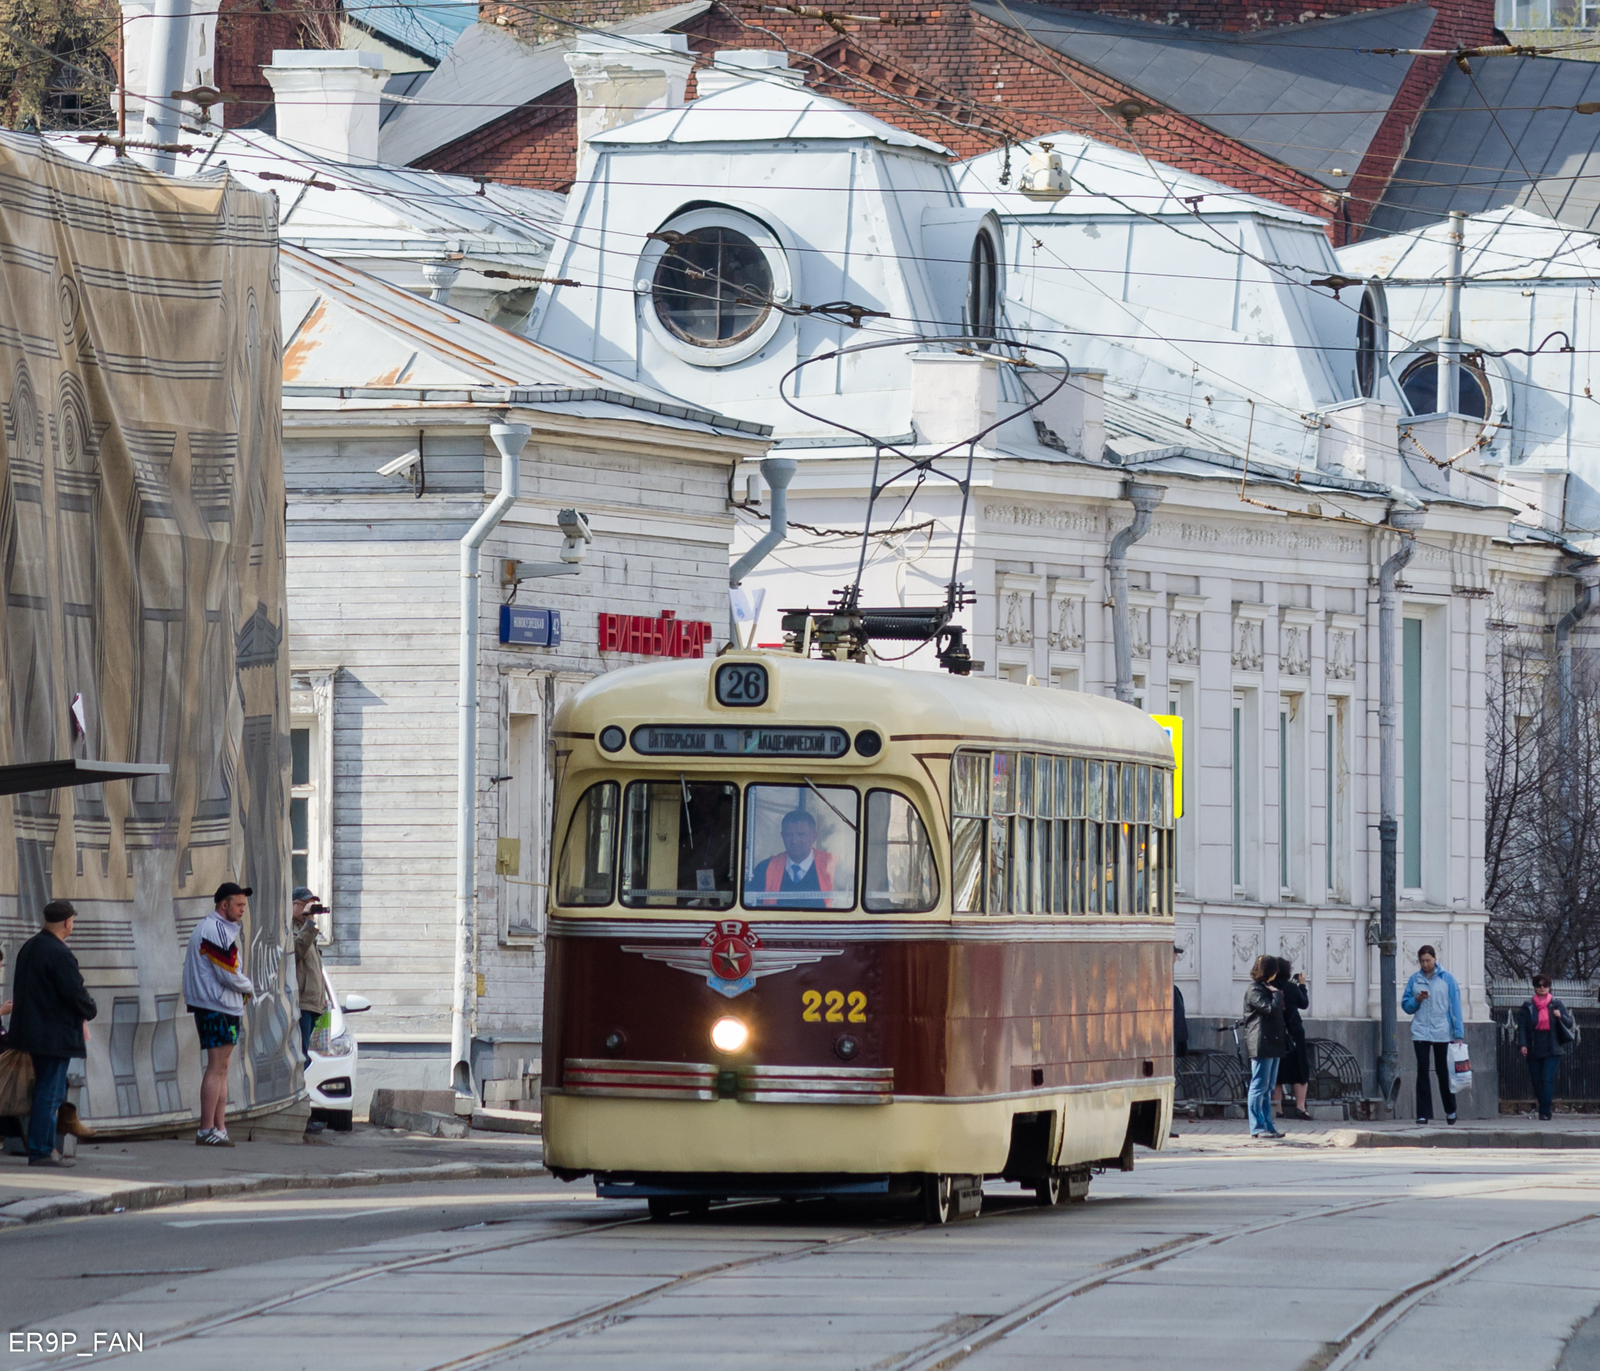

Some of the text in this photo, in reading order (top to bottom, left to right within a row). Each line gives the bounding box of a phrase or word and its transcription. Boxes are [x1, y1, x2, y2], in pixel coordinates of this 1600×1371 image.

[600, 609, 713, 659] ВИННЫЙ БАР
[726, 670, 761, 700] 26
[802, 989, 867, 1023] 222
